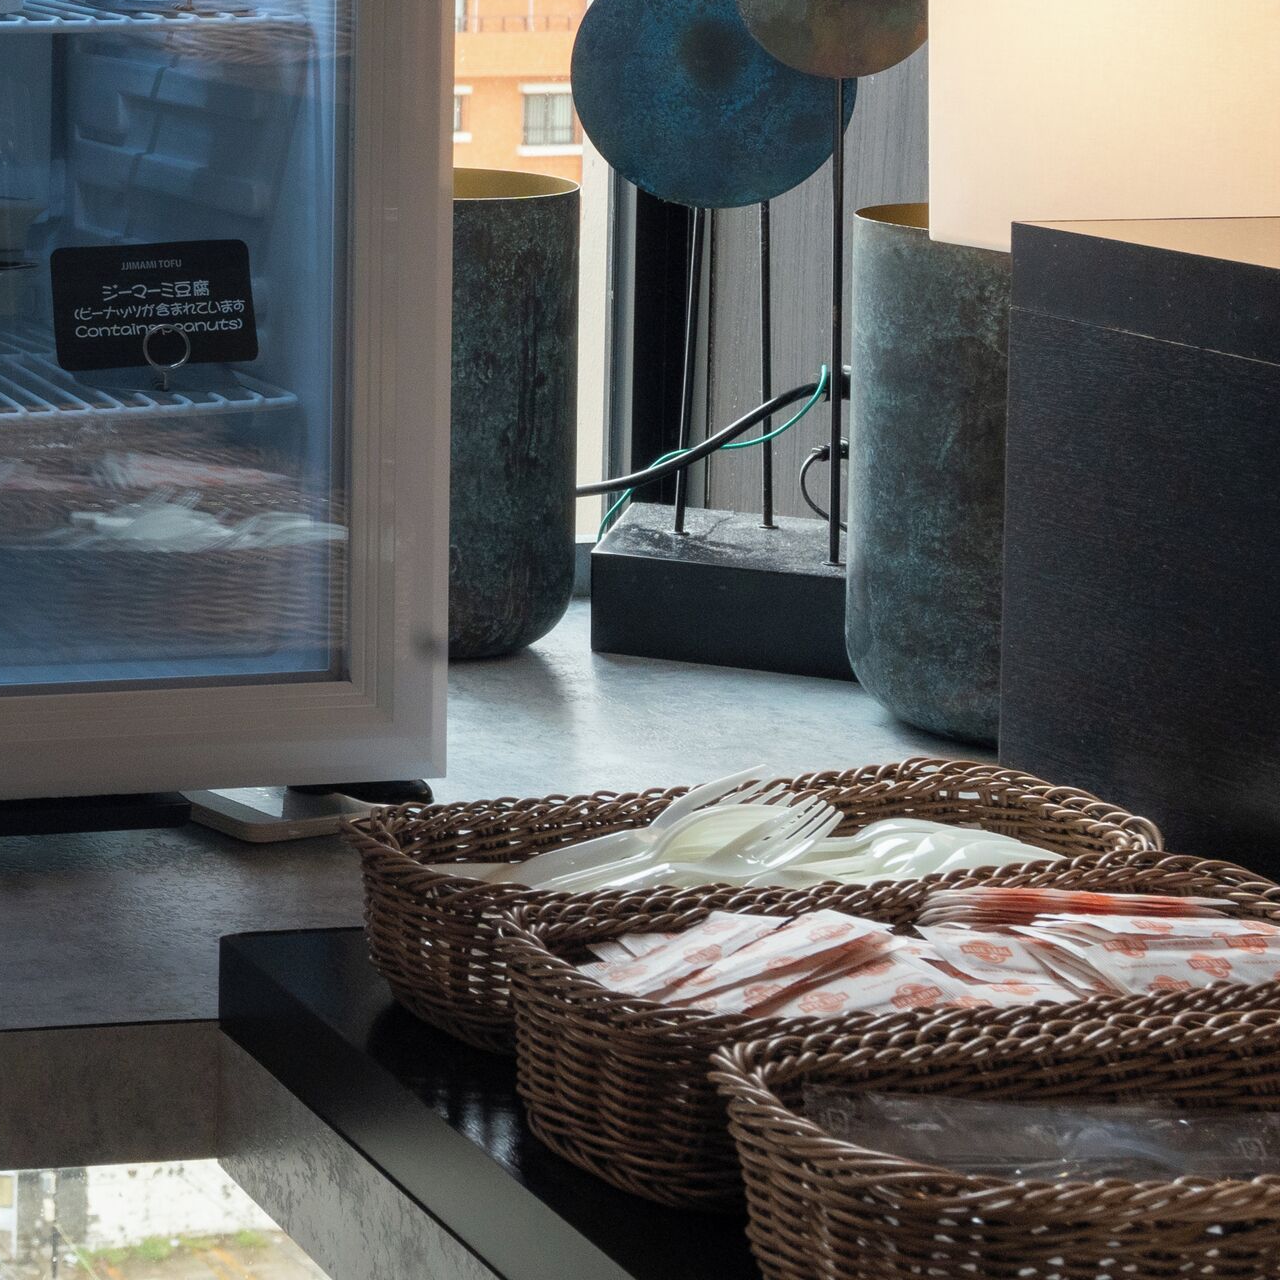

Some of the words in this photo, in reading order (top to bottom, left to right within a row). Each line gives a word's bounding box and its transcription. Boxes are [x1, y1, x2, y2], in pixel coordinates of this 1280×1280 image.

[158, 259, 182, 270] TOFU
[102, 279, 210, 302] ジーマーミ豆腐
